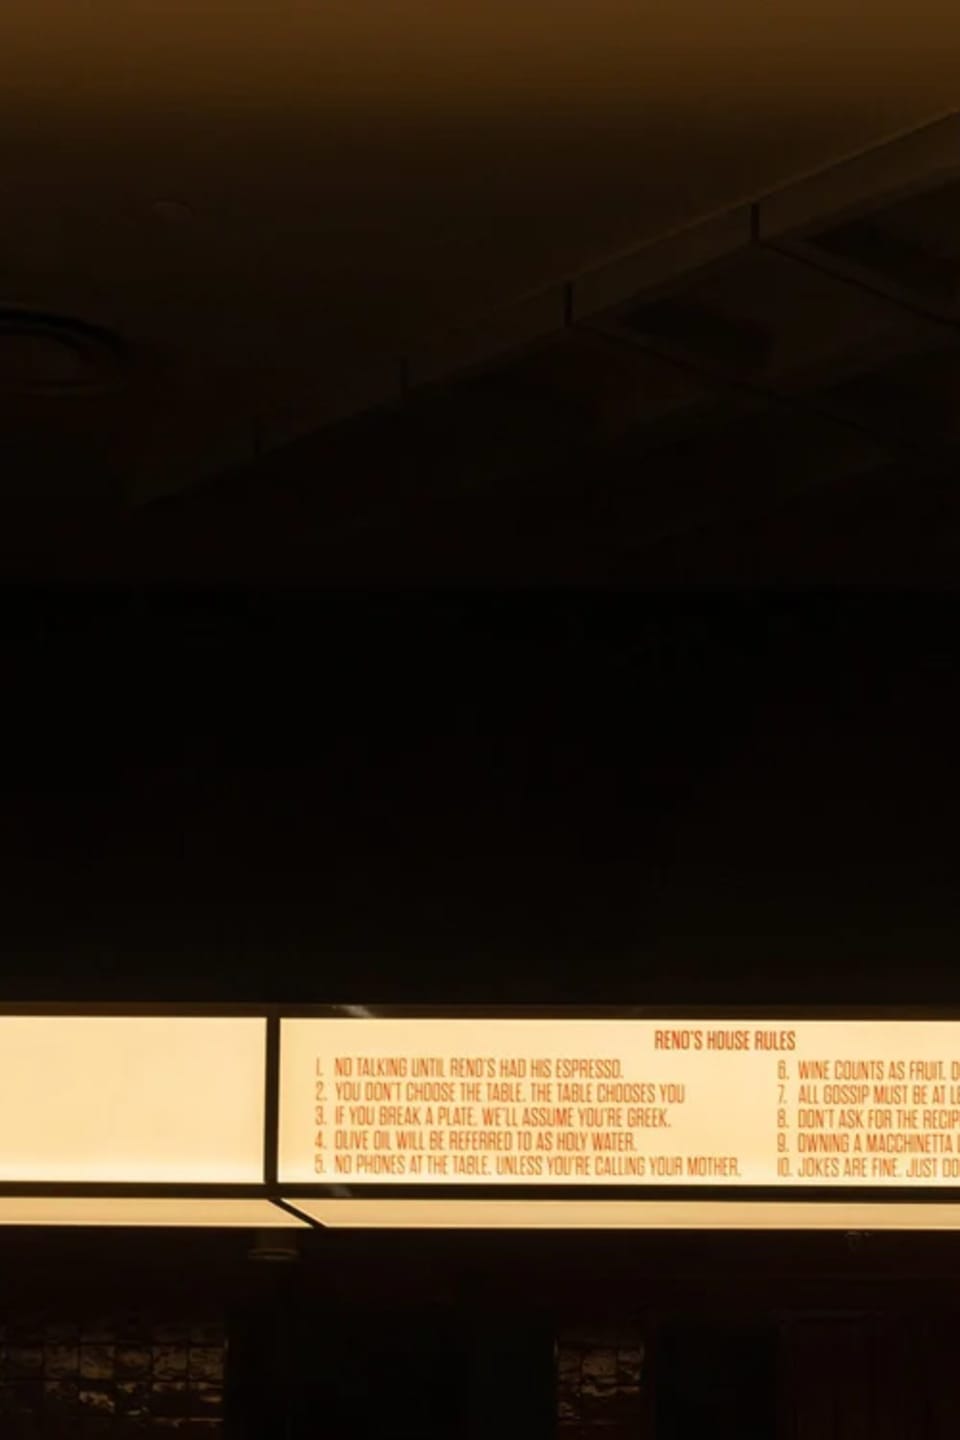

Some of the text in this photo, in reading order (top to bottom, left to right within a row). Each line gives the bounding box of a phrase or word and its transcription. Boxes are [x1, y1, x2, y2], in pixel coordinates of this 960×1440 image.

[654, 1030, 796, 1051] RENO'S HOUSE RULES
[335, 1057, 352, 1077] NO
[356, 1057, 407, 1077] TALKING
[411, 1057, 444, 1077] UNTIL
[450, 1057, 496, 1077] RENO'S
[500, 1057, 525, 1077] HAD
[531, 1059, 552, 1078] HIS
[556, 1059, 623, 1078] ESPRESSO.
[777, 1060, 789, 1080] 6.
[798, 1060, 830, 1080] WINE
[834, 1060, 884, 1080] COUNTS
[889, 1060, 905, 1080] AS
[909, 1060, 946, 1080] FRUIT.
[316, 1082, 327, 1102] 2.
[335, 1082, 360, 1102] YOU
[365, 1082, 401, 1102] DON'T
[406, 1082, 456, 1102] CHOOSE
[460, 1082, 482, 1102] THE
[531, 1083, 552, 1103] THE
[557, 1083, 592, 1103] TABLE
[597, 1083, 656, 1103] CHOOSES
[660, 1083, 685, 1103] YOU
[777, 1085, 787, 1104] 7.
[798, 1085, 819, 1104] ALL
[823, 1085, 870, 1104] GOSSIP
[874, 1085, 908, 1104] MUST
[913, 1085, 928, 1104] BE
[932, 1085, 945, 1104] AT
[315, 1106, 327, 1126] 3.
[335, 1106, 346, 1126] IF
[349, 1106, 375, 1126] YOU
[379, 1106, 420, 1126] BREAK
[426, 1106, 433, 1126] A
[482, 1106, 518, 1126] WE'LL
[522, 1107, 574, 1127] ASSUME
[578, 1107, 622, 1127] YOU'RE
[627, 1107, 671, 1127] GREEK.
[777, 1109, 789, 1129] 8.
[798, 1109, 834, 1129] DON'T
[838, 1109, 864, 1129] ASK
[868, 1109, 892, 1129] FOR
[896, 1109, 918, 1129] THE
[315, 1130, 637, 1151] 4. OLIVE OIL WILL BE REFERRED TO AS HOLY WATER.
[777, 1133, 789, 1153] 9.
[798, 1133, 849, 1153] OWNING
[854, 1133, 861, 1153] A
[866, 1133, 952, 1153] MACCHINETTA
[315, 1155, 326, 1174] 5.
[335, 1155, 352, 1174] NO
[356, 1155, 405, 1174] PHONES
[409, 1155, 423, 1174] AT
[427, 1155, 448, 1174] THE
[495, 1156, 542, 1175] UNLESS
[546, 1156, 590, 1175] YOU'RE
[595, 1156, 646, 1175] CALLING
[650, 1156, 682, 1175] YOUR
[687, 1157, 741, 1177] MOTHER.
[777, 1157, 793, 1177] 10.
[798, 1157, 840, 1177] JOKES
[844, 1157, 867, 1177] ARE
[906, 1157, 938, 1177] JUST
